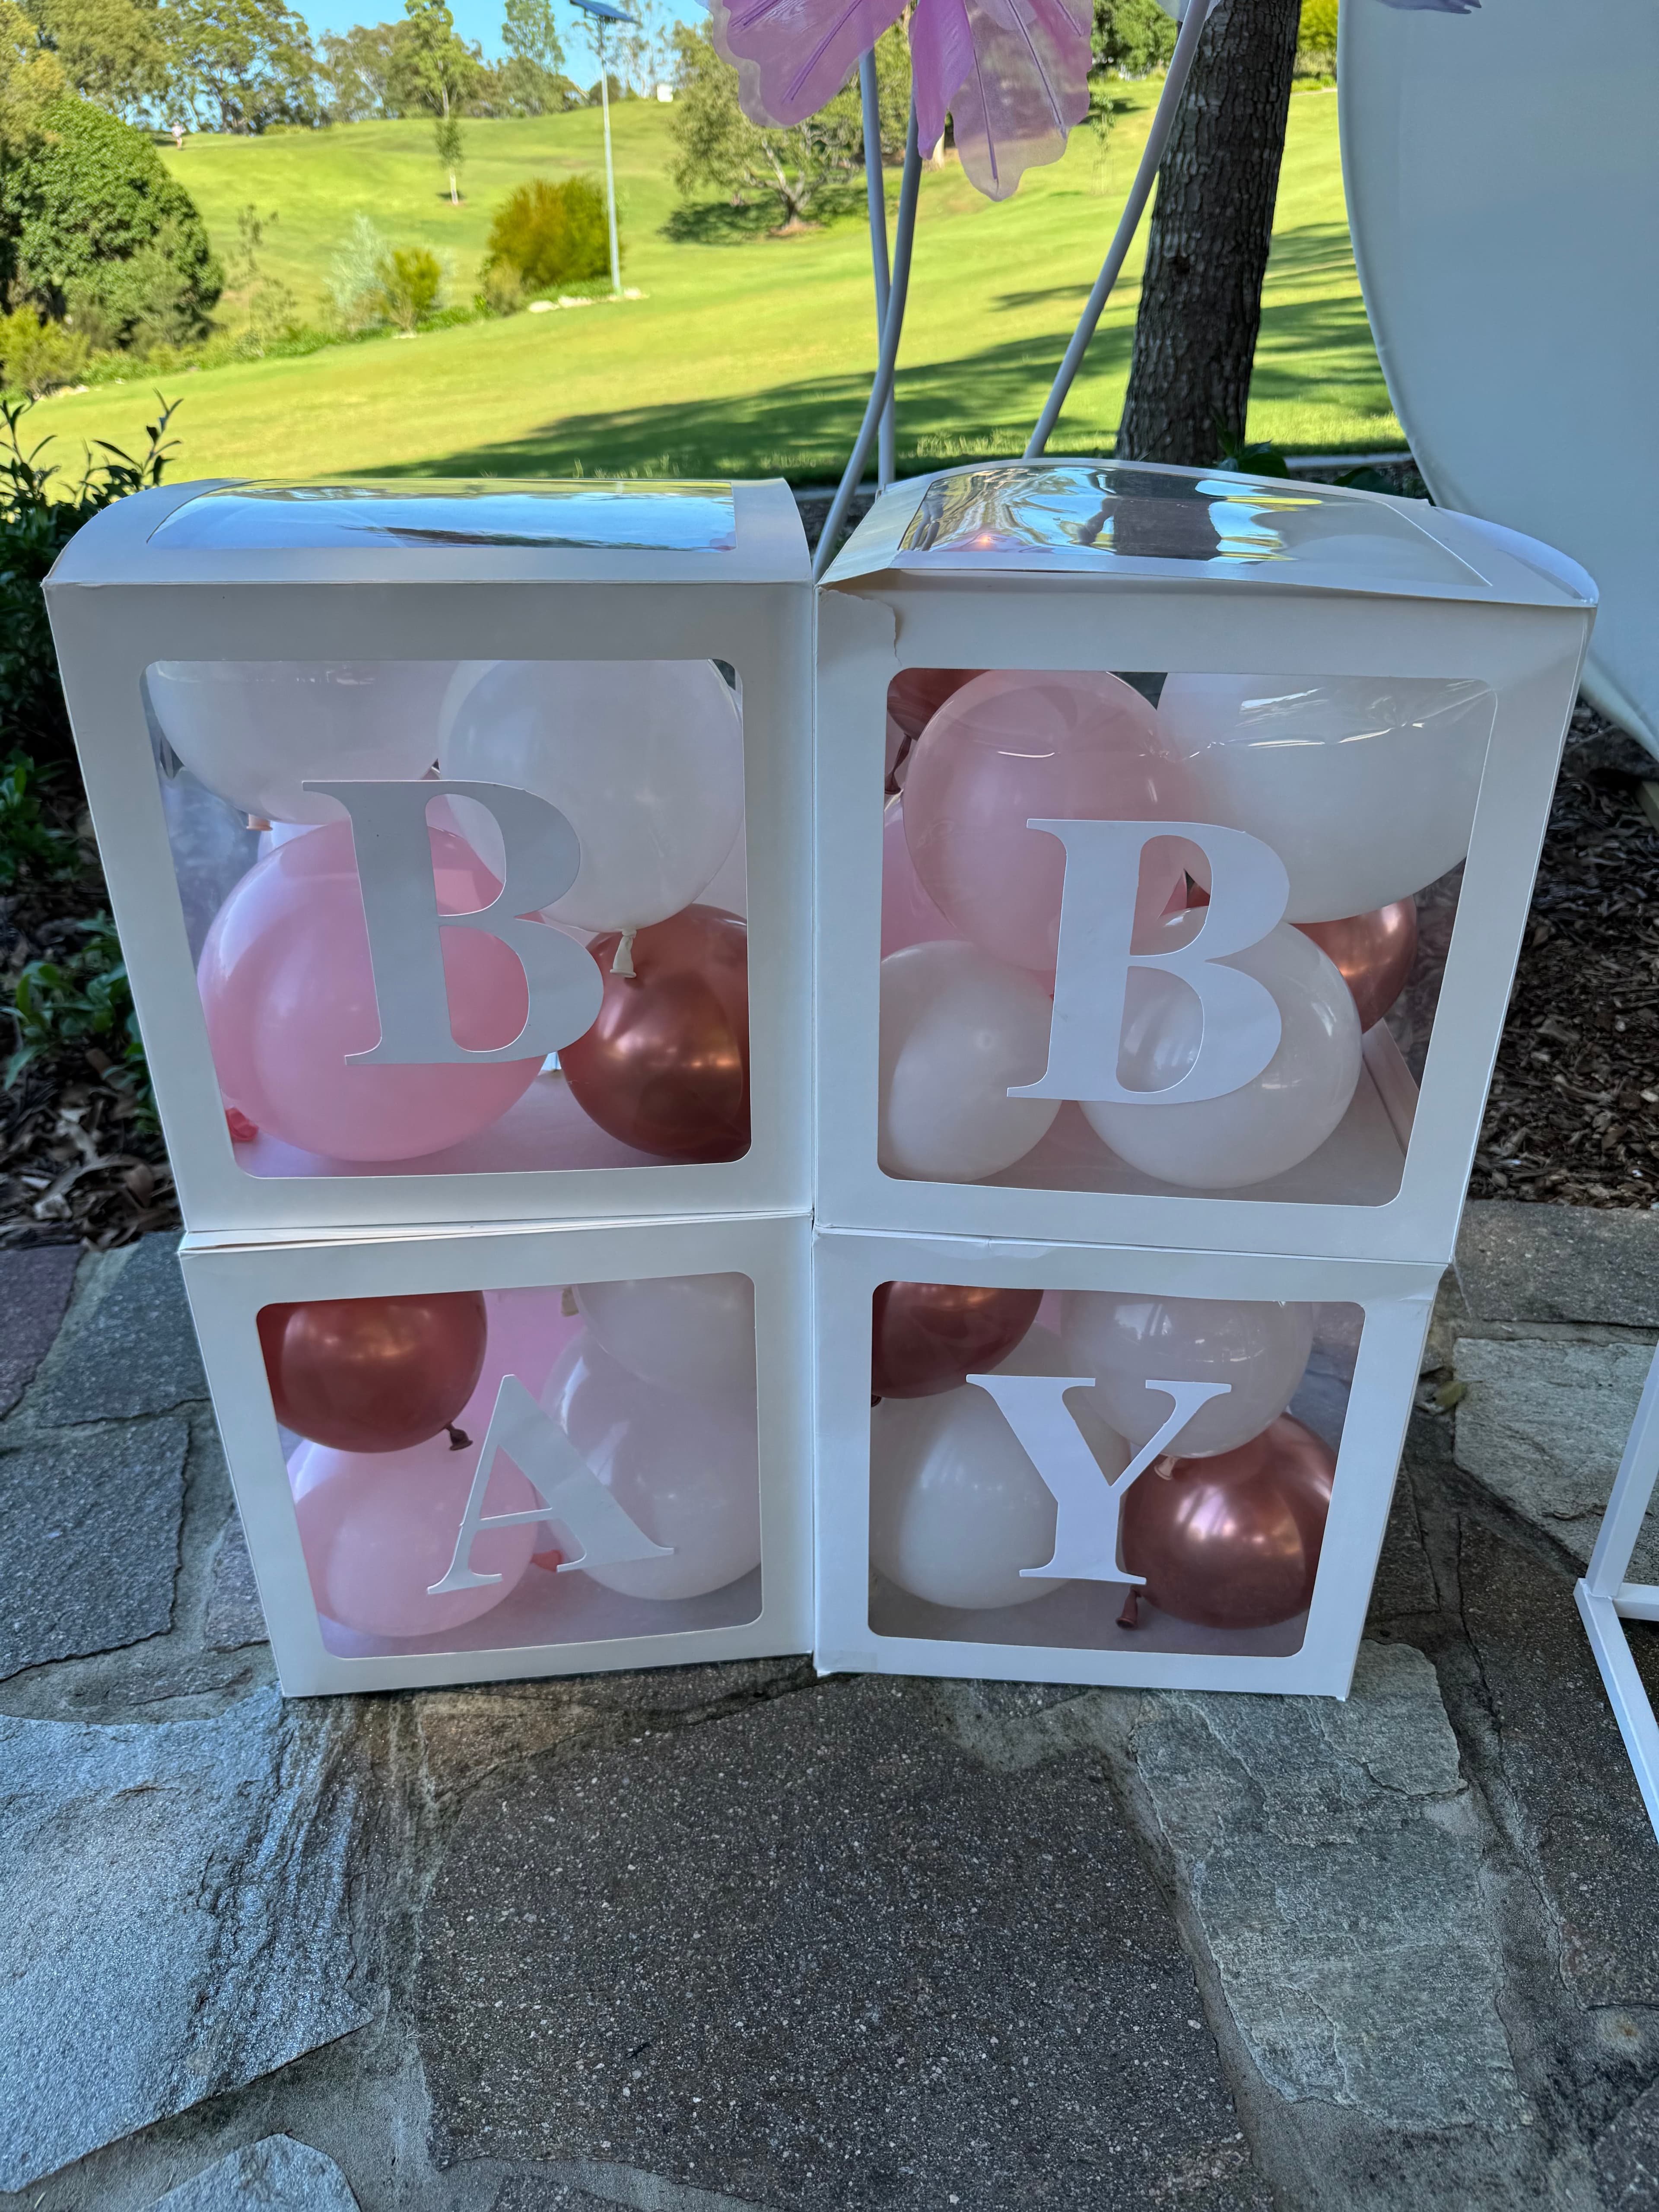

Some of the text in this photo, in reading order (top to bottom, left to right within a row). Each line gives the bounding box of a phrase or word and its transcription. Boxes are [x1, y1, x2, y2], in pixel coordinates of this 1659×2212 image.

[302, 780, 604, 1065] B
[1007, 818, 1290, 1105] B
[427, 1374, 674, 1595] A
[966, 1374, 1232, 1586] Y
